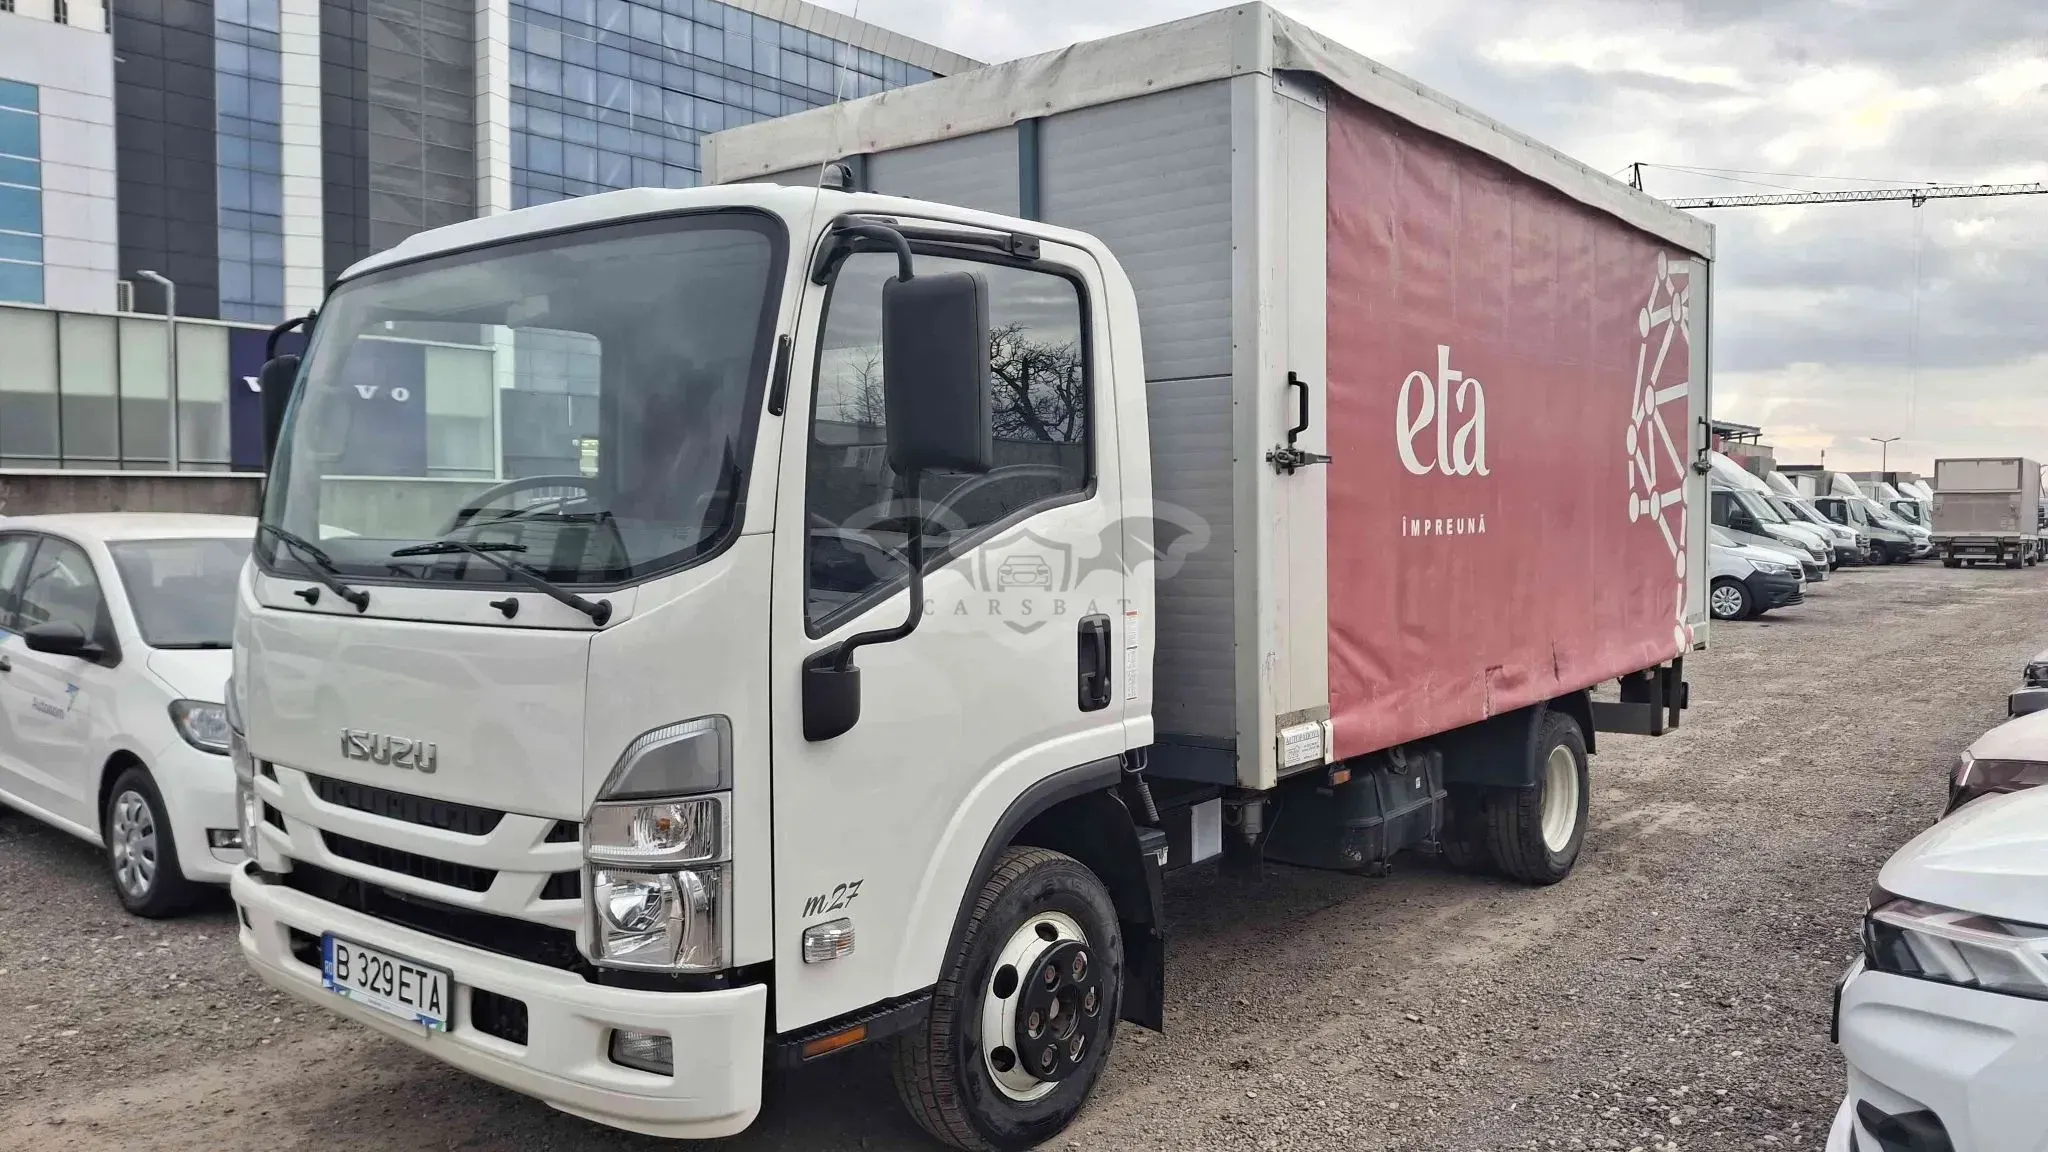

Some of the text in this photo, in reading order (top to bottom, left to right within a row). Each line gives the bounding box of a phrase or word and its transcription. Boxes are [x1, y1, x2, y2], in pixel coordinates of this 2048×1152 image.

[1396, 344, 1490, 476] eta
[1402, 514, 1487, 537] ÎMPREUNĂ
[341, 727, 437, 774] ISUZU
[336, 944, 441, 1015] B 329 ETA
